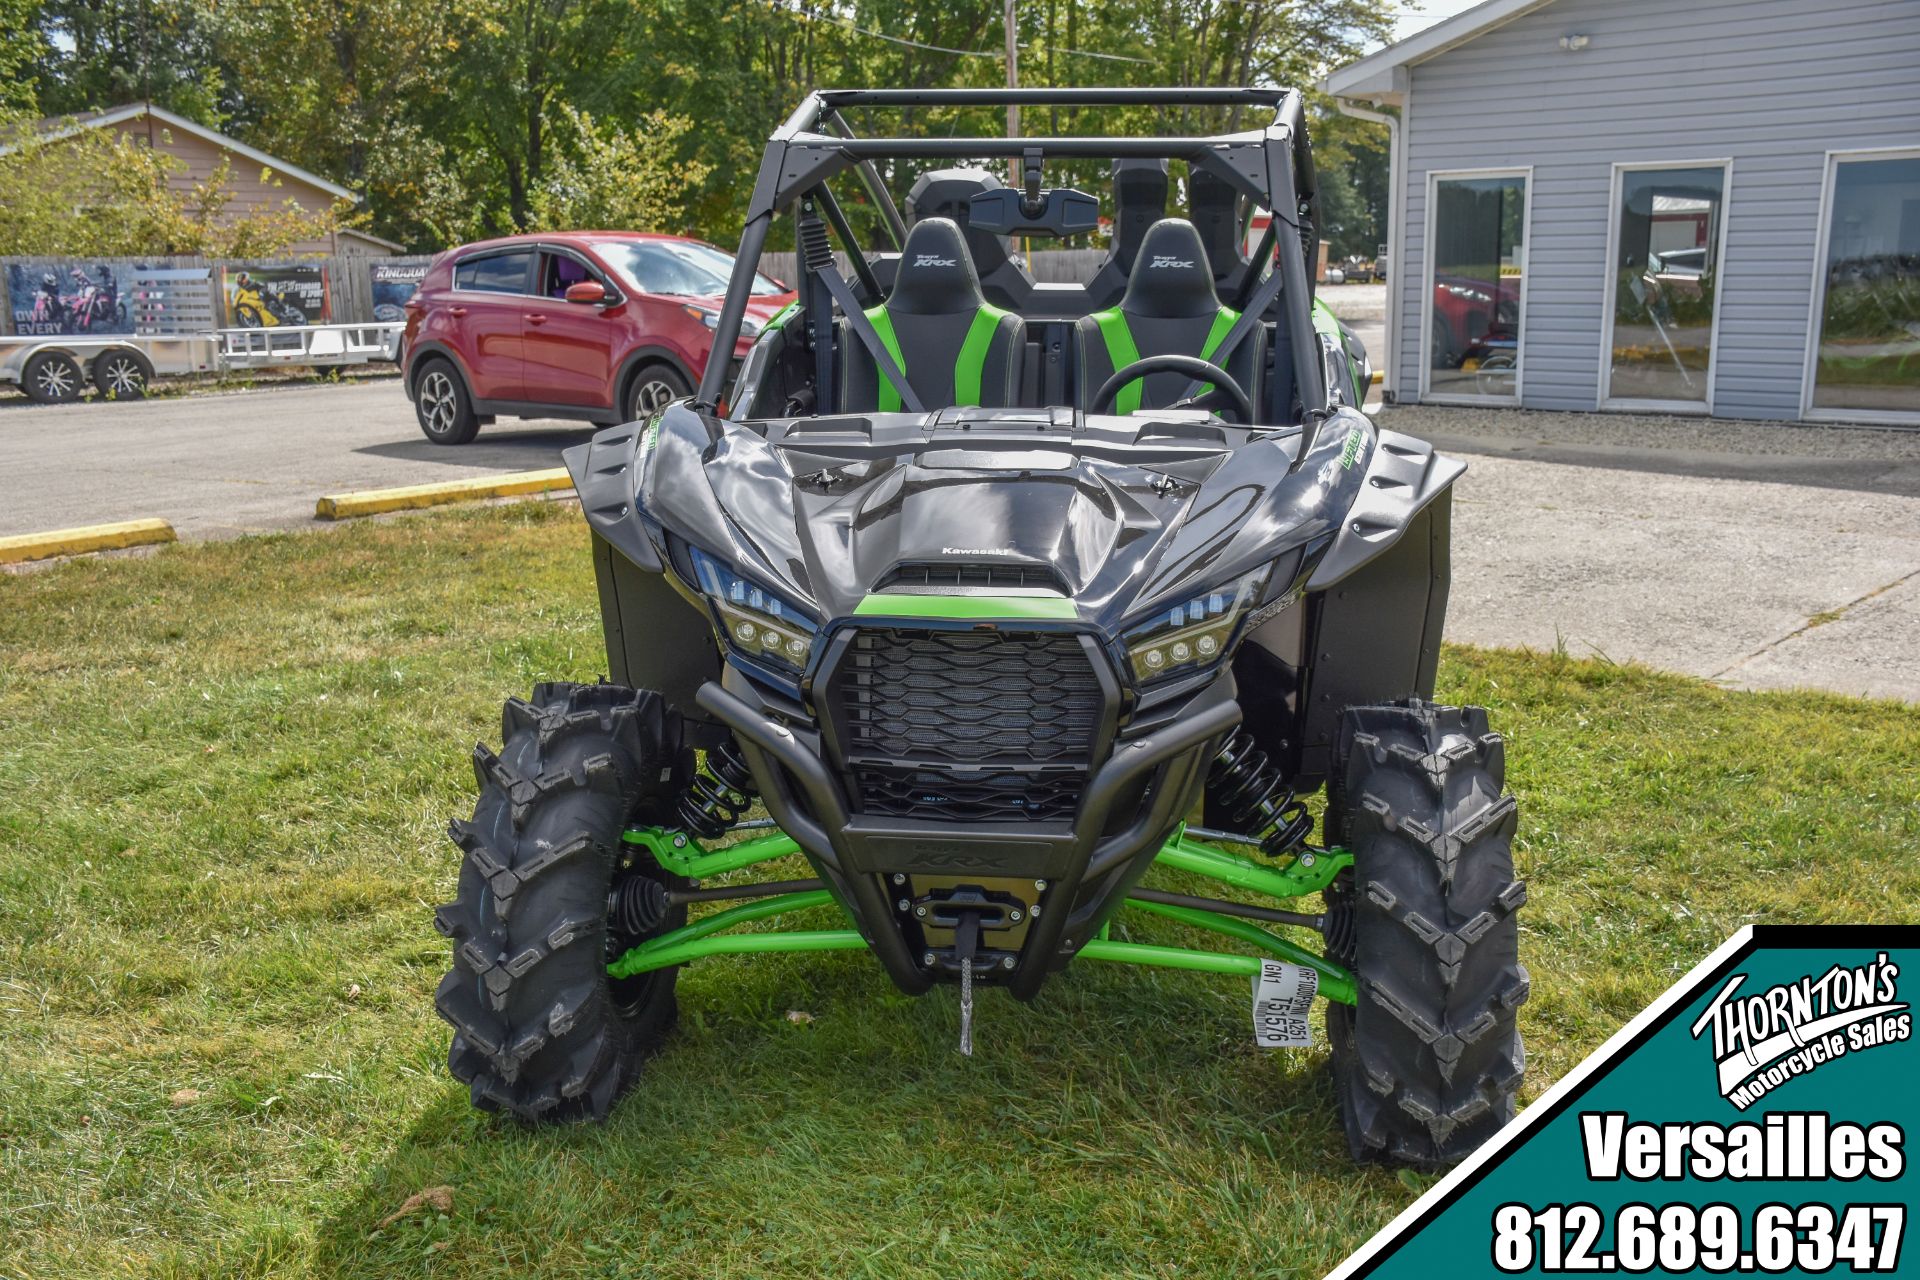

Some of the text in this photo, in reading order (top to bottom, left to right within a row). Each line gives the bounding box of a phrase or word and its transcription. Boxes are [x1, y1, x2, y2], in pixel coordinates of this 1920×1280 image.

[1150, 260, 1194, 268] KRX
[16, 310, 49, 321] OWN
[17, 322, 62, 335] EVERY
[942, 547, 1009, 556] Kawasaki
[1263, 964, 1282, 984] GN1
[1265, 997, 1293, 1042] T51576
[1288, 1018, 1307, 1040] A251
